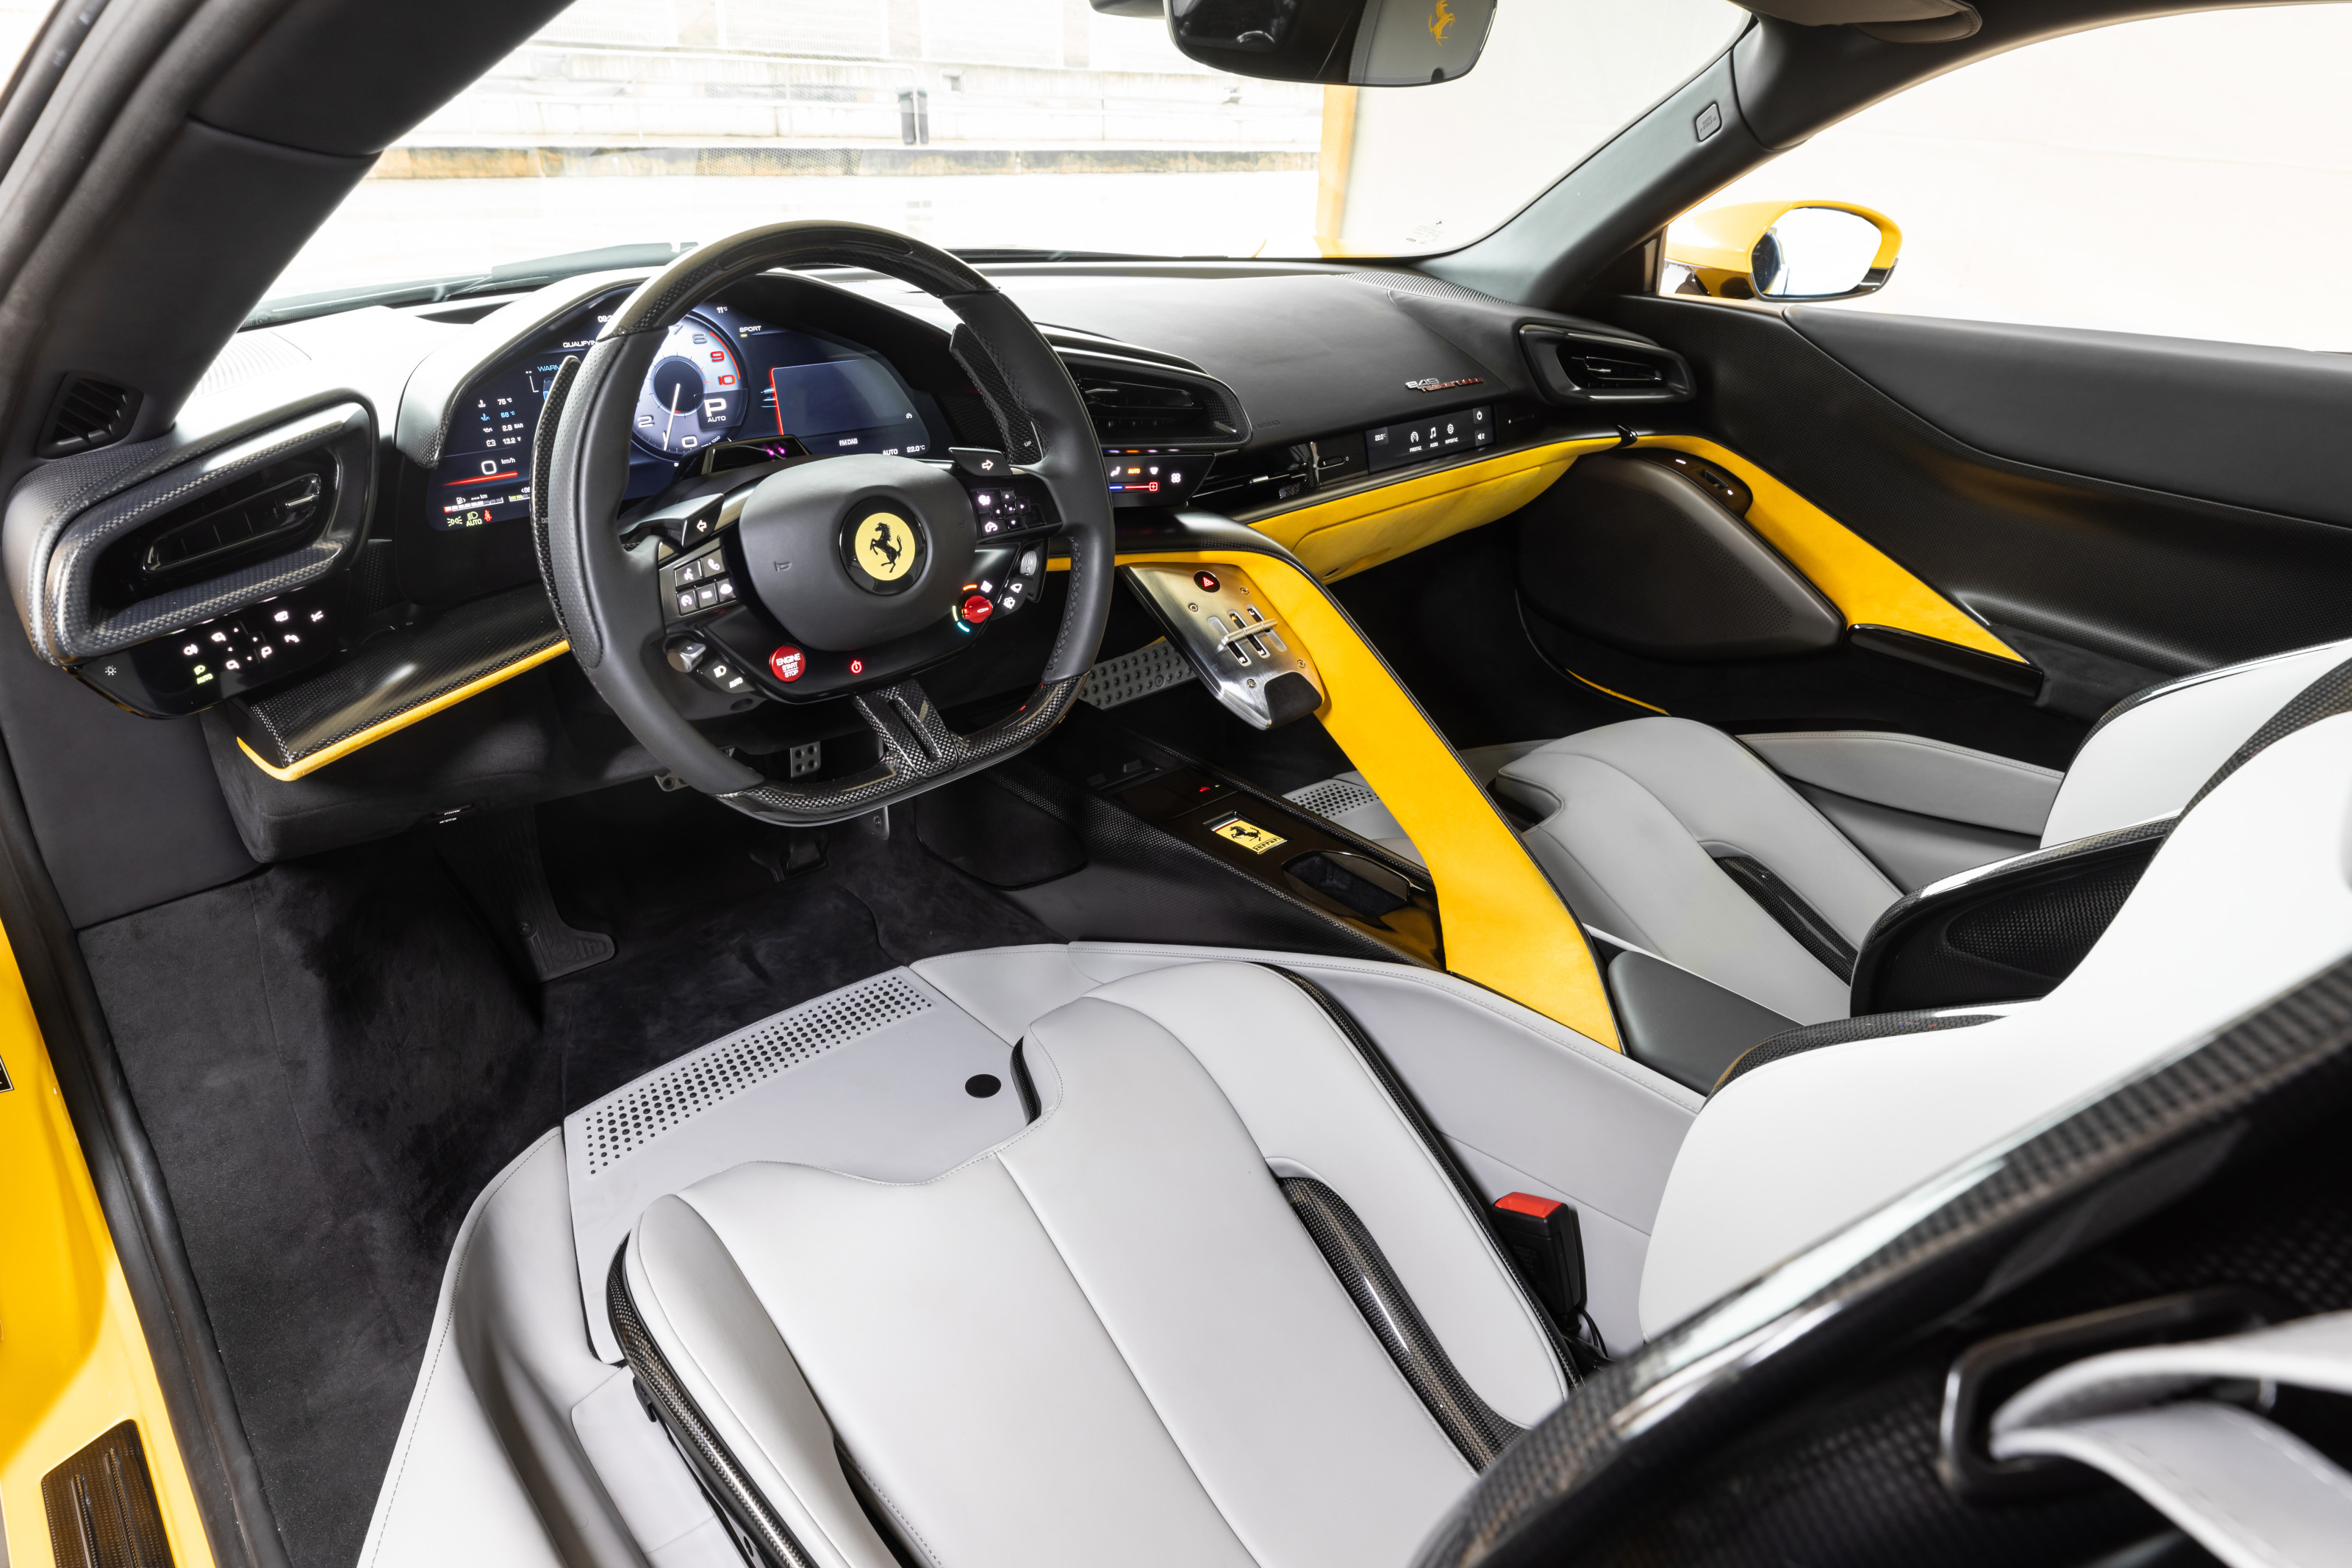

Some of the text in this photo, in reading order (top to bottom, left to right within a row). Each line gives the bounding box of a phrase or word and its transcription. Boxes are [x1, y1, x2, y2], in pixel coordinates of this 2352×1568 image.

[562, 340, 597, 348] QUALIFYIN
[692, 332, 707, 345] 8
[710, 350, 725, 362] 9
[718, 374, 736, 386] 10
[703, 398, 727, 417] P
[637, 415, 653, 428] 2
[707, 415, 726, 423] AUTO
[681, 436, 698, 448] 0
[481, 460, 497, 475] 0
[466, 519, 482, 527] AUTO
[776, 653, 800, 666] ENGINE
[782, 662, 797, 670] START
[196, 673, 213, 684] AUTO
[784, 669, 799, 677] STOP
[729, 677, 743, 688] AUTO
